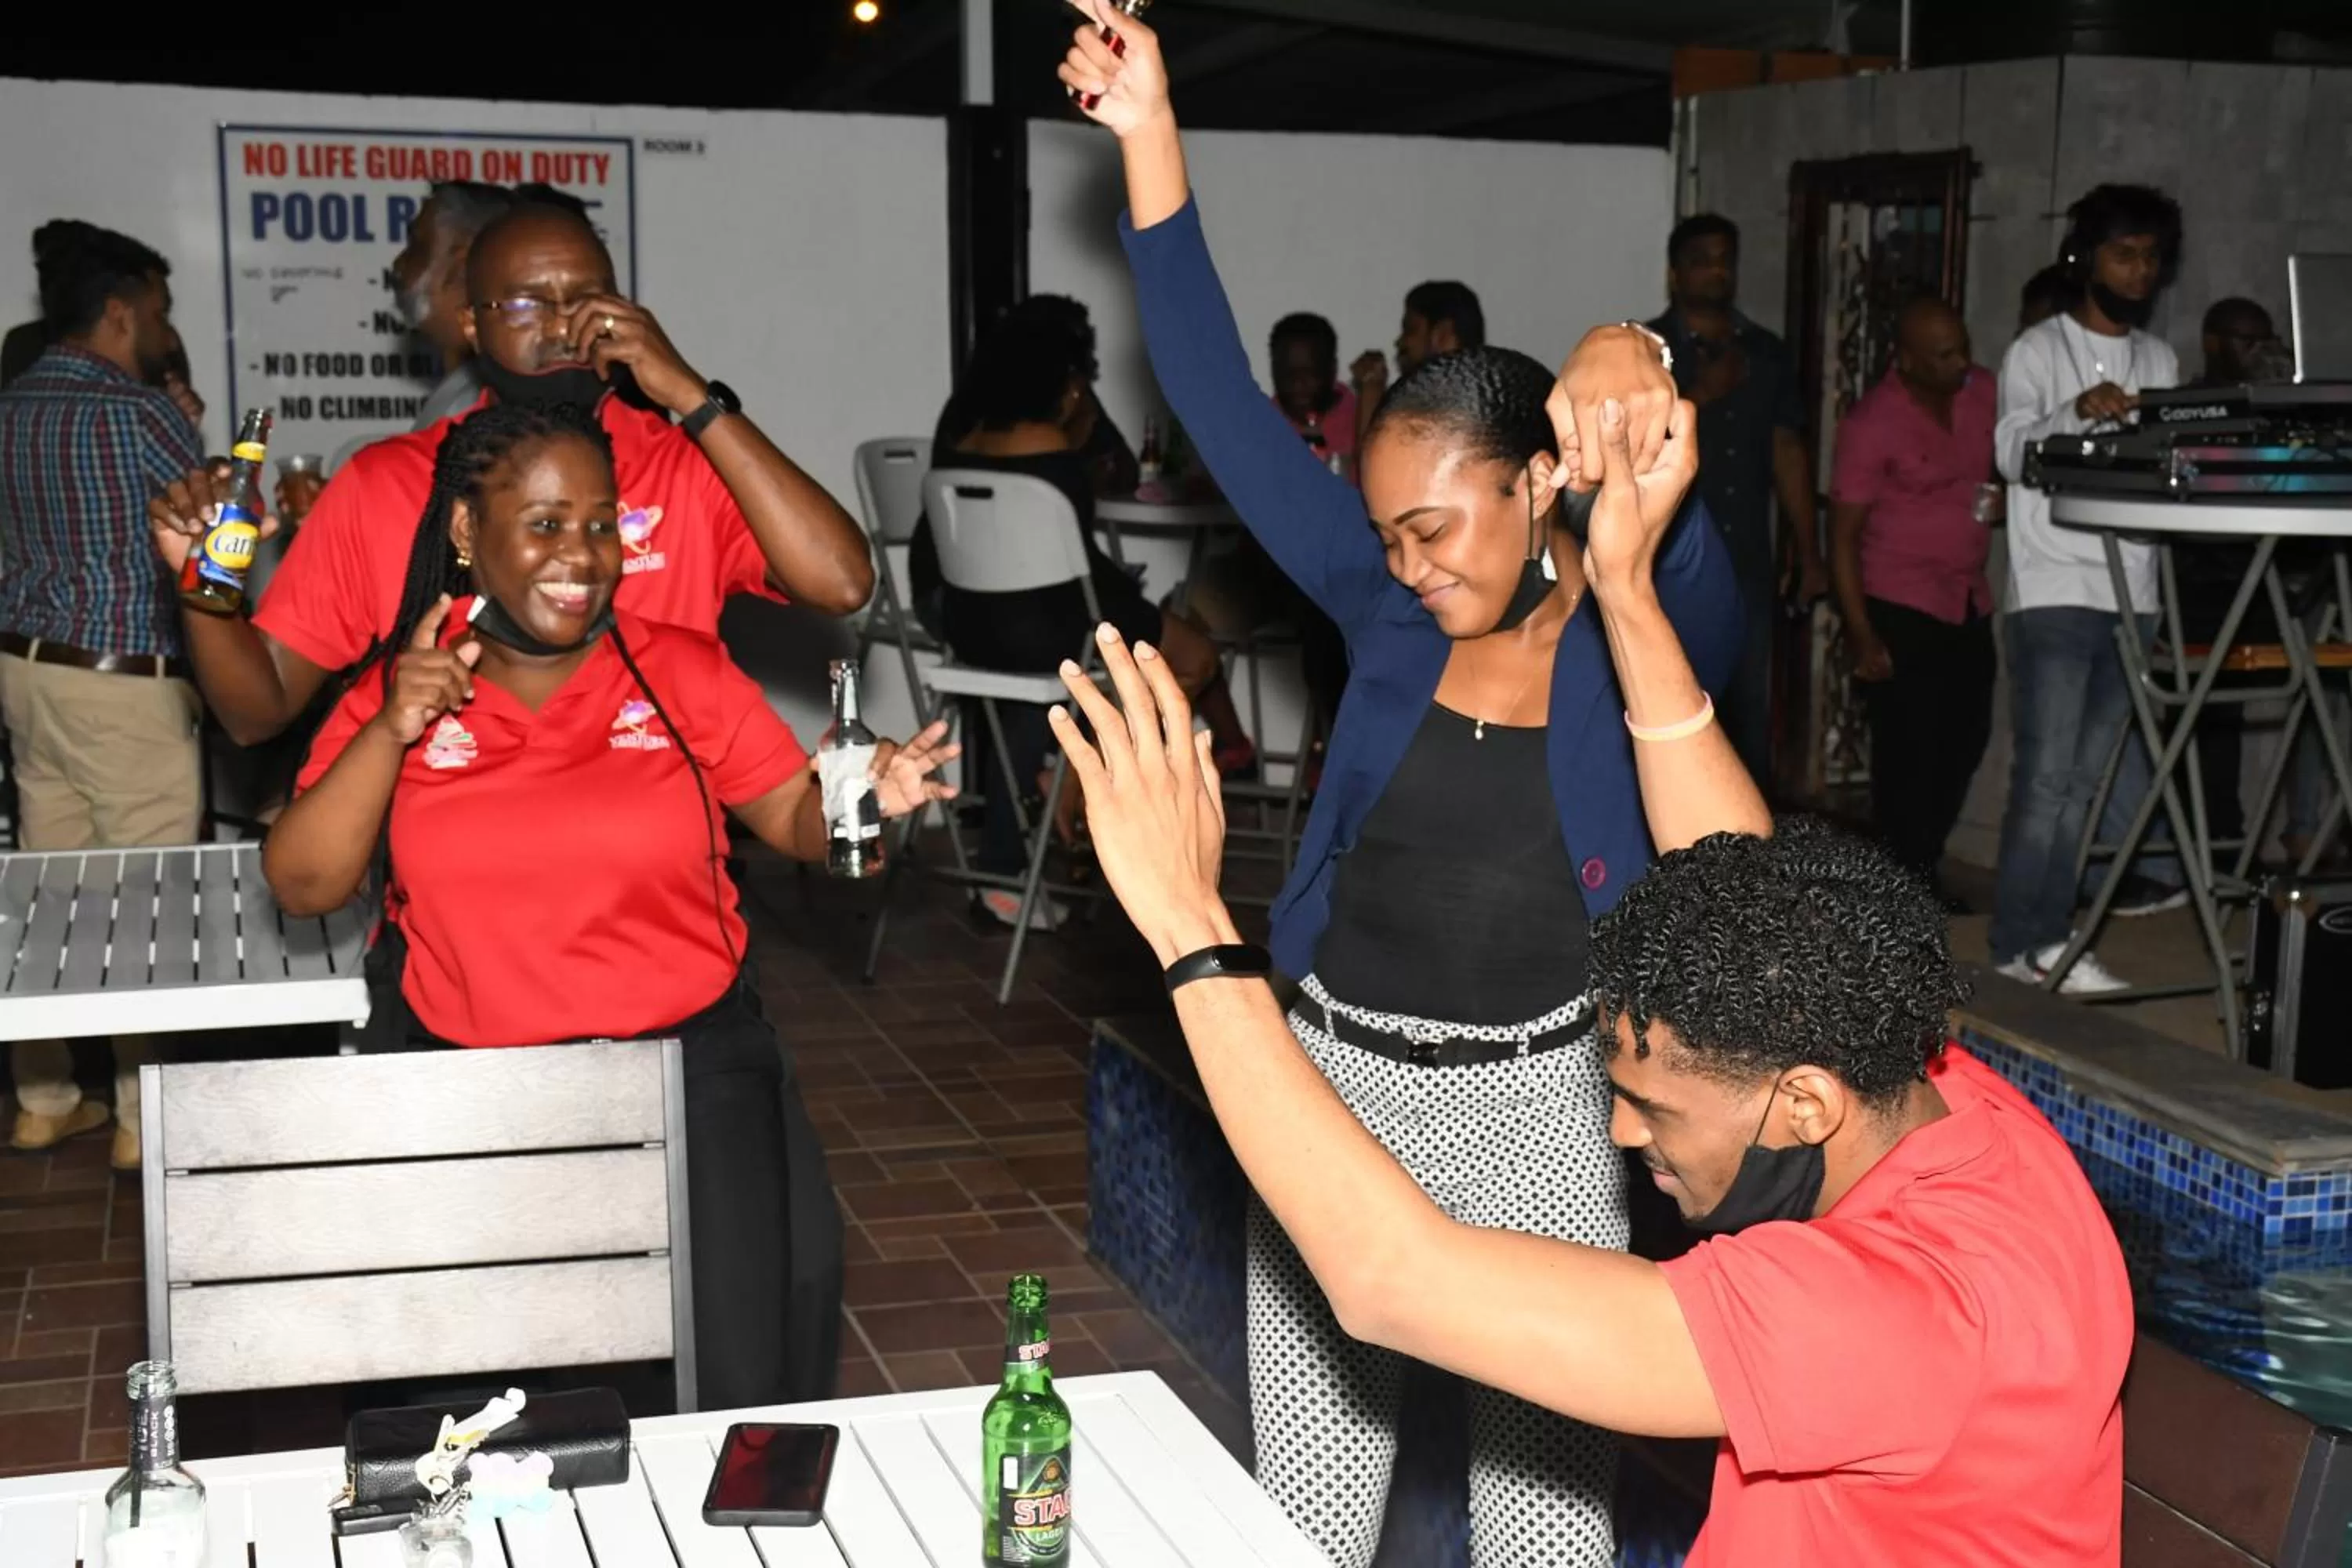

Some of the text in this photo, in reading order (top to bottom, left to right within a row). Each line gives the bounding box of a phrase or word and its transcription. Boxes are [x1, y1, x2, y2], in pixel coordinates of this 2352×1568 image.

[244, 142, 610, 186] NO LIFE GUARD ON DUTY
[251, 191, 376, 243] POOL
[264, 353, 296, 377] NO
[303, 353, 364, 378] FOOD
[371, 354, 402, 378] OR
[280, 395, 311, 420] NO
[150, 1410, 159, 1457] BLACK
